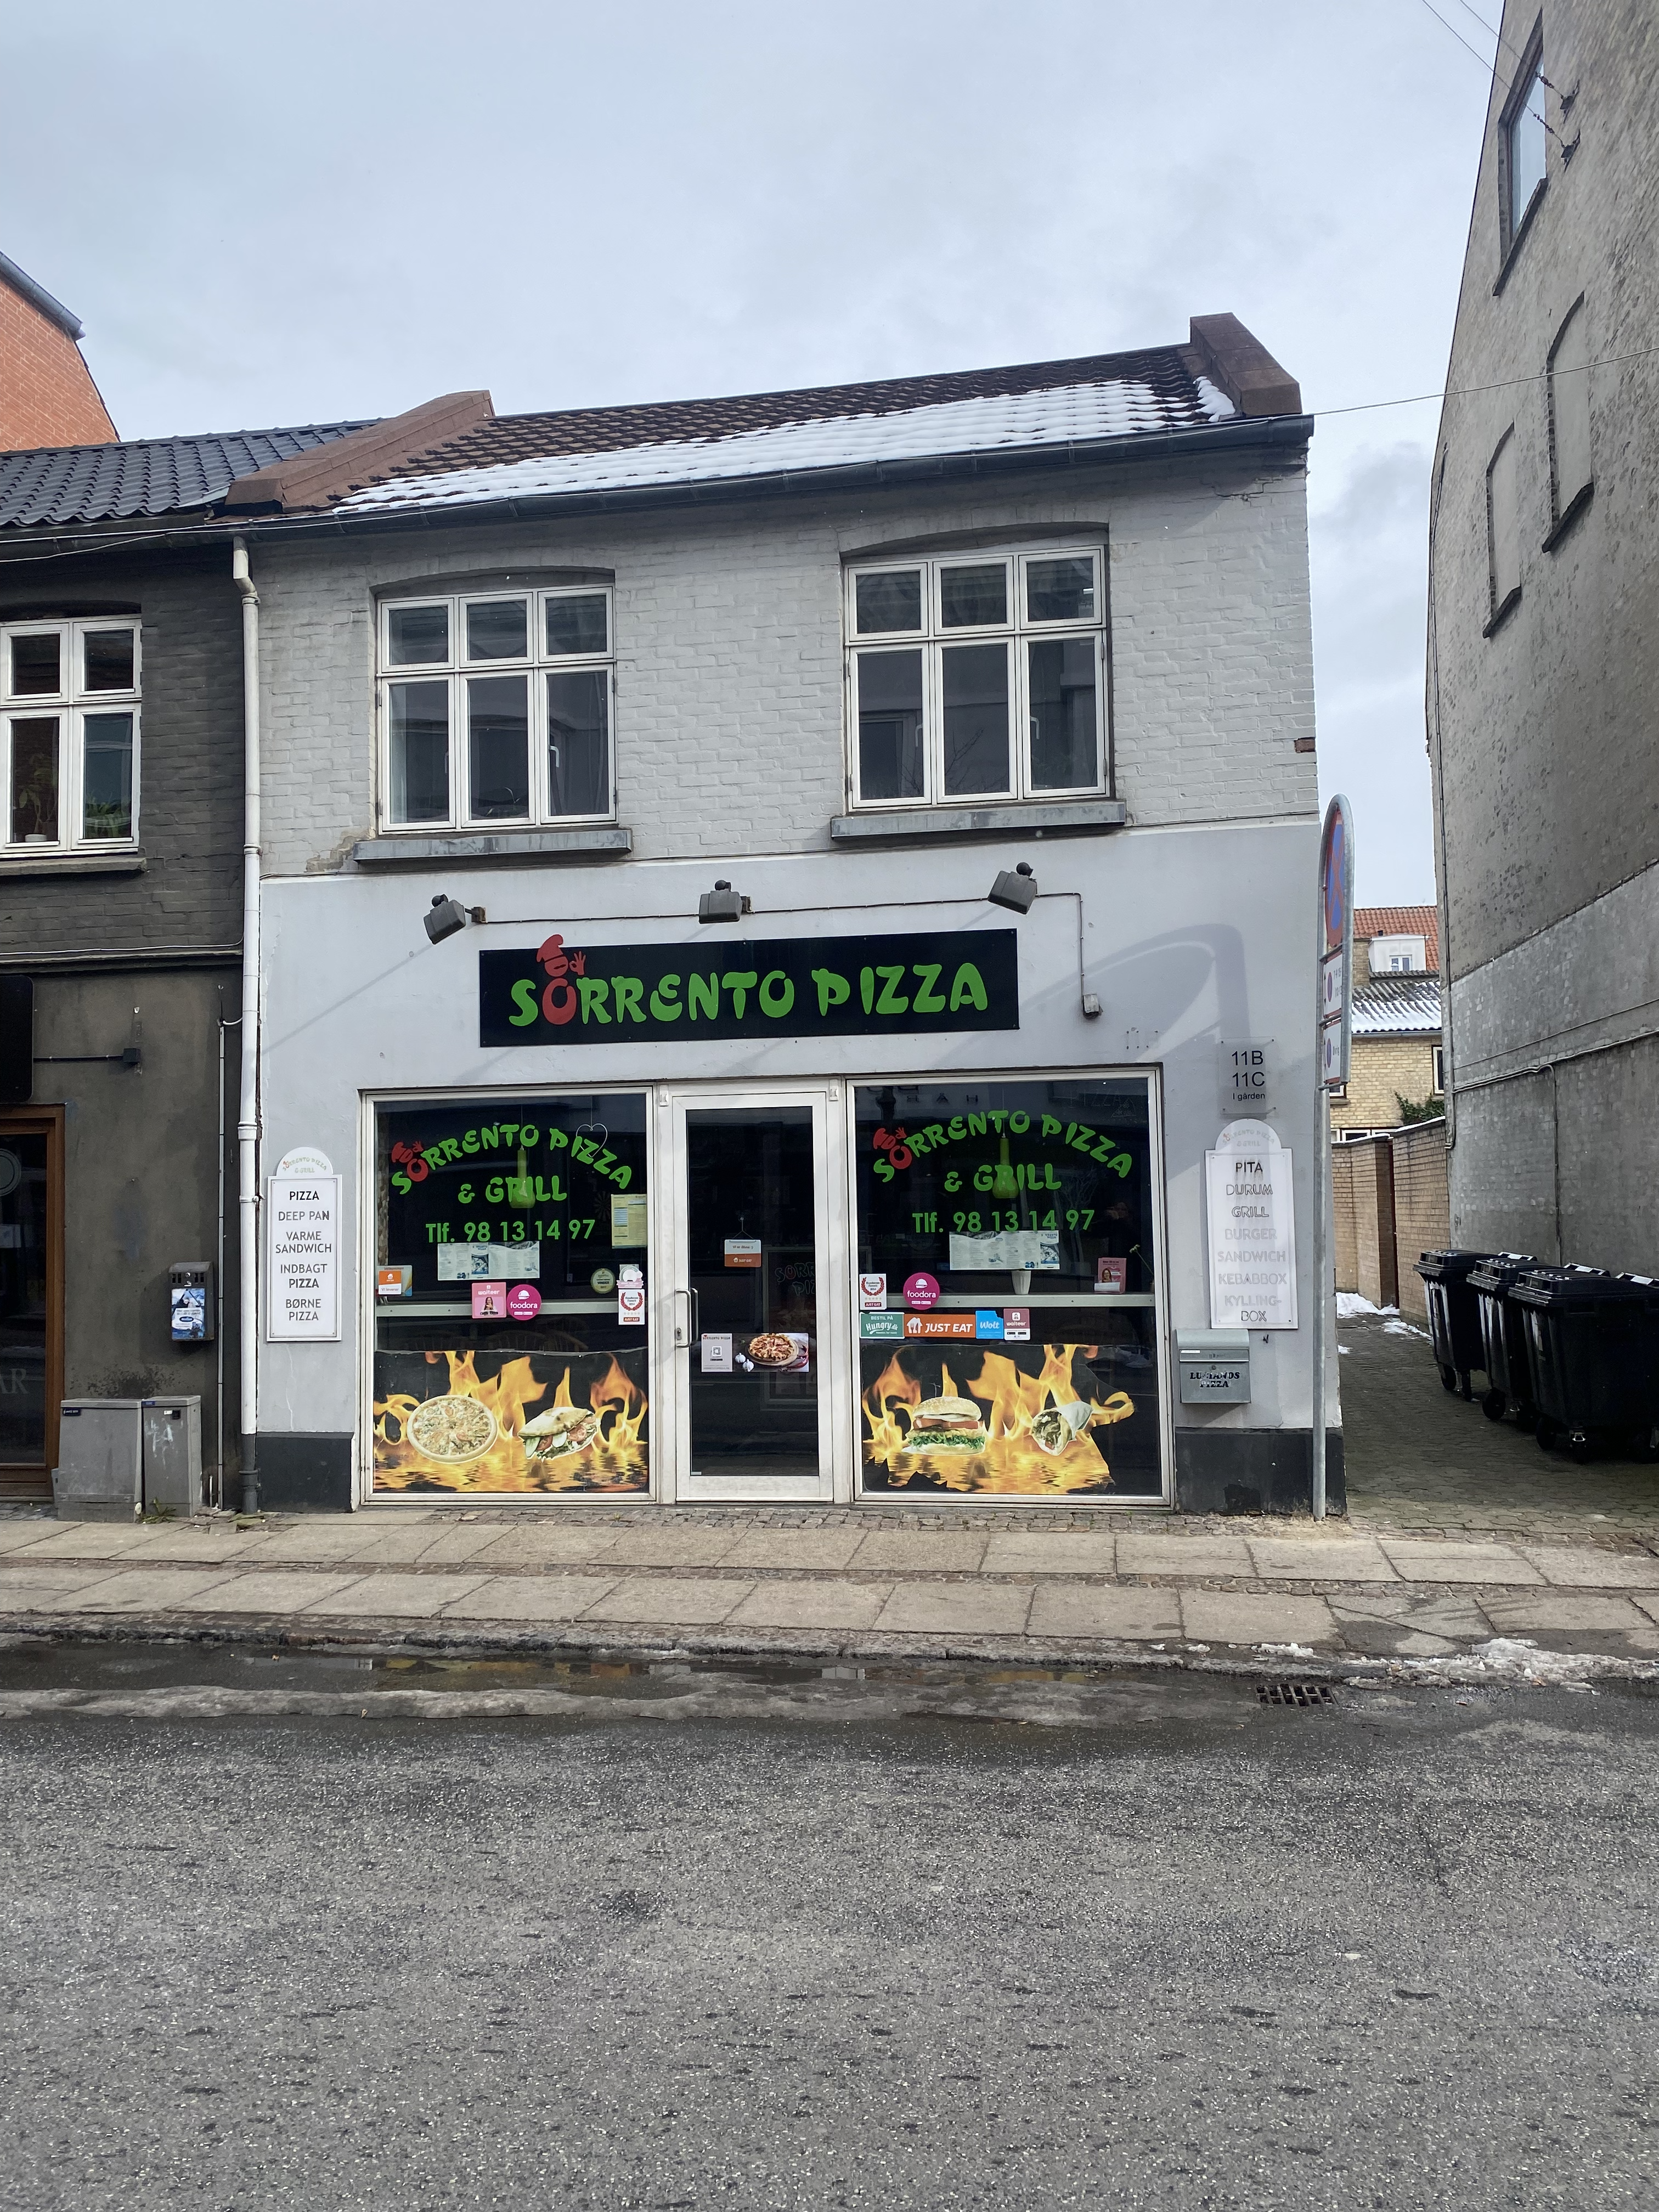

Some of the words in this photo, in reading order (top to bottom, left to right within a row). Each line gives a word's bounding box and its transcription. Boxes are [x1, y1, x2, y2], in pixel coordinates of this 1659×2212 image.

[509, 970, 794, 1026] SORRENTO
[811, 962, 988, 1017] PIZZA
[1232, 1050, 1263, 1065] 11B
[1232, 1071, 1265, 1087] 11C
[1238, 1092, 1265, 1101] gården
[873, 1110, 1030, 1182] SORRENTO
[1041, 1114, 1132, 1178] PIZZA
[283, 1157, 310, 1171] SORRENTO
[311, 1158, 327, 1171] PIZZA
[392, 1124, 539, 1195] SORRENTO
[549, 1128, 632, 1189] PIZZA
[1235, 1162, 1263, 1173] PITA
[944, 1172, 963, 1192] &
[973, 1164, 1062, 1191] GRILL
[458, 1184, 475, 1204] &
[486, 1175, 567, 1203] GRILL
[1226, 1184, 1273, 1195] DURUM
[289, 1190, 319, 1201] PIZZA
[278, 1211, 305, 1221] DEEP
[309, 1210, 329, 1221] PAN
[1231, 1206, 1269, 1218] GRILL
[912, 1213, 944, 1233] Tlf.
[953, 1212, 981, 1232] 98
[991, 1211, 1018, 1232] 13
[1029, 1210, 1057, 1231] 14
[1066, 1210, 1095, 1230] 97
[286, 1231, 321, 1241] VARME
[425, 1223, 455, 1243] Tlf.
[464, 1222, 490, 1242] 98
[500, 1221, 525, 1241] 13
[534, 1220, 560, 1240] 14
[569, 1219, 596, 1239] 97
[1225, 1228, 1277, 1240] BURGER
[275, 1243, 332, 1254] SANDWICH
[1218, 1251, 1285, 1262] SANDWICH
[280, 1263, 328, 1274] INDBAGT
[289, 1278, 319, 1288] PIZZA
[1218, 1273, 1287, 1285] KEBABBOX
[286, 1299, 321, 1309] BØRNE
[1224, 1295, 1282, 1307] KYLLING-
[289, 1311, 319, 1321] PIZZA
[1241, 1311, 1267, 1322] BOX
[924, 1323, 951, 1333] JUST
[952, 1323, 973, 1333] EAT
[979, 1321, 1000, 1329] Wolt
